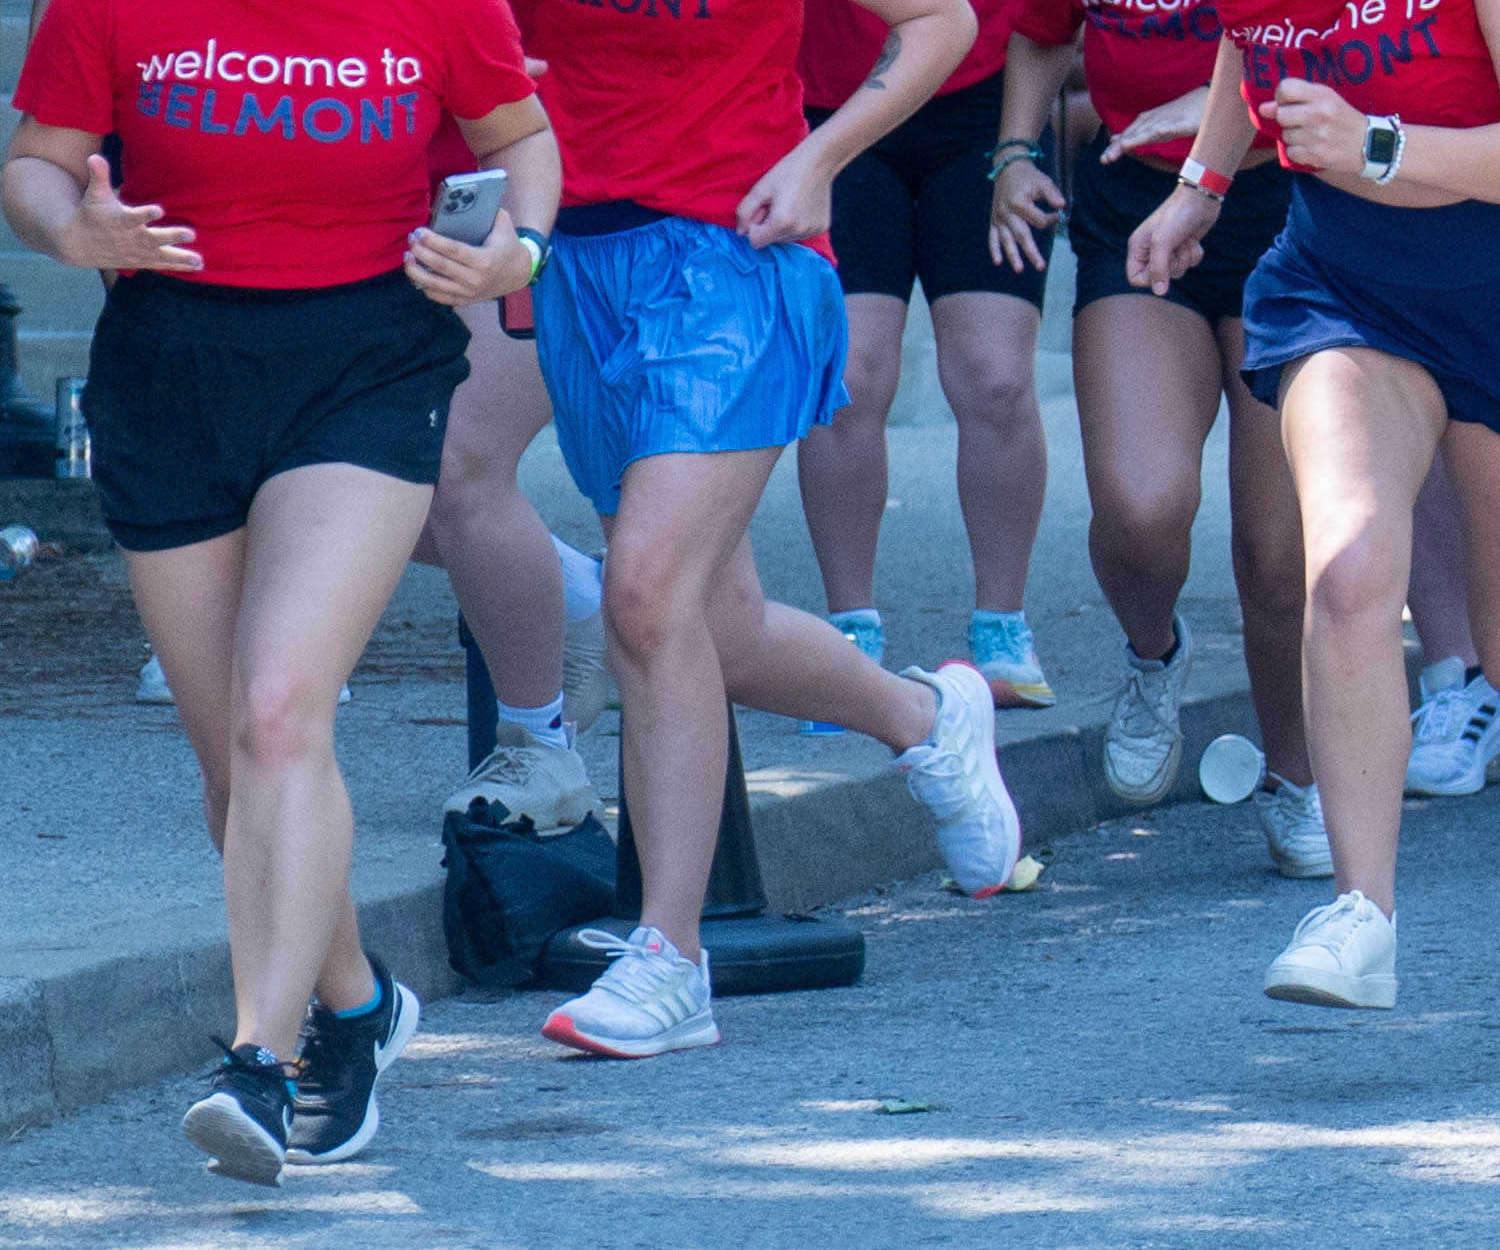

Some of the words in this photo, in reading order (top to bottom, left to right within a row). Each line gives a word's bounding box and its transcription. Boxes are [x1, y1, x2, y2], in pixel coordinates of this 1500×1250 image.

[136, 37, 369, 89] welcome
[381, 47, 422, 87] to
[136, 80, 420, 145] BELMONT
